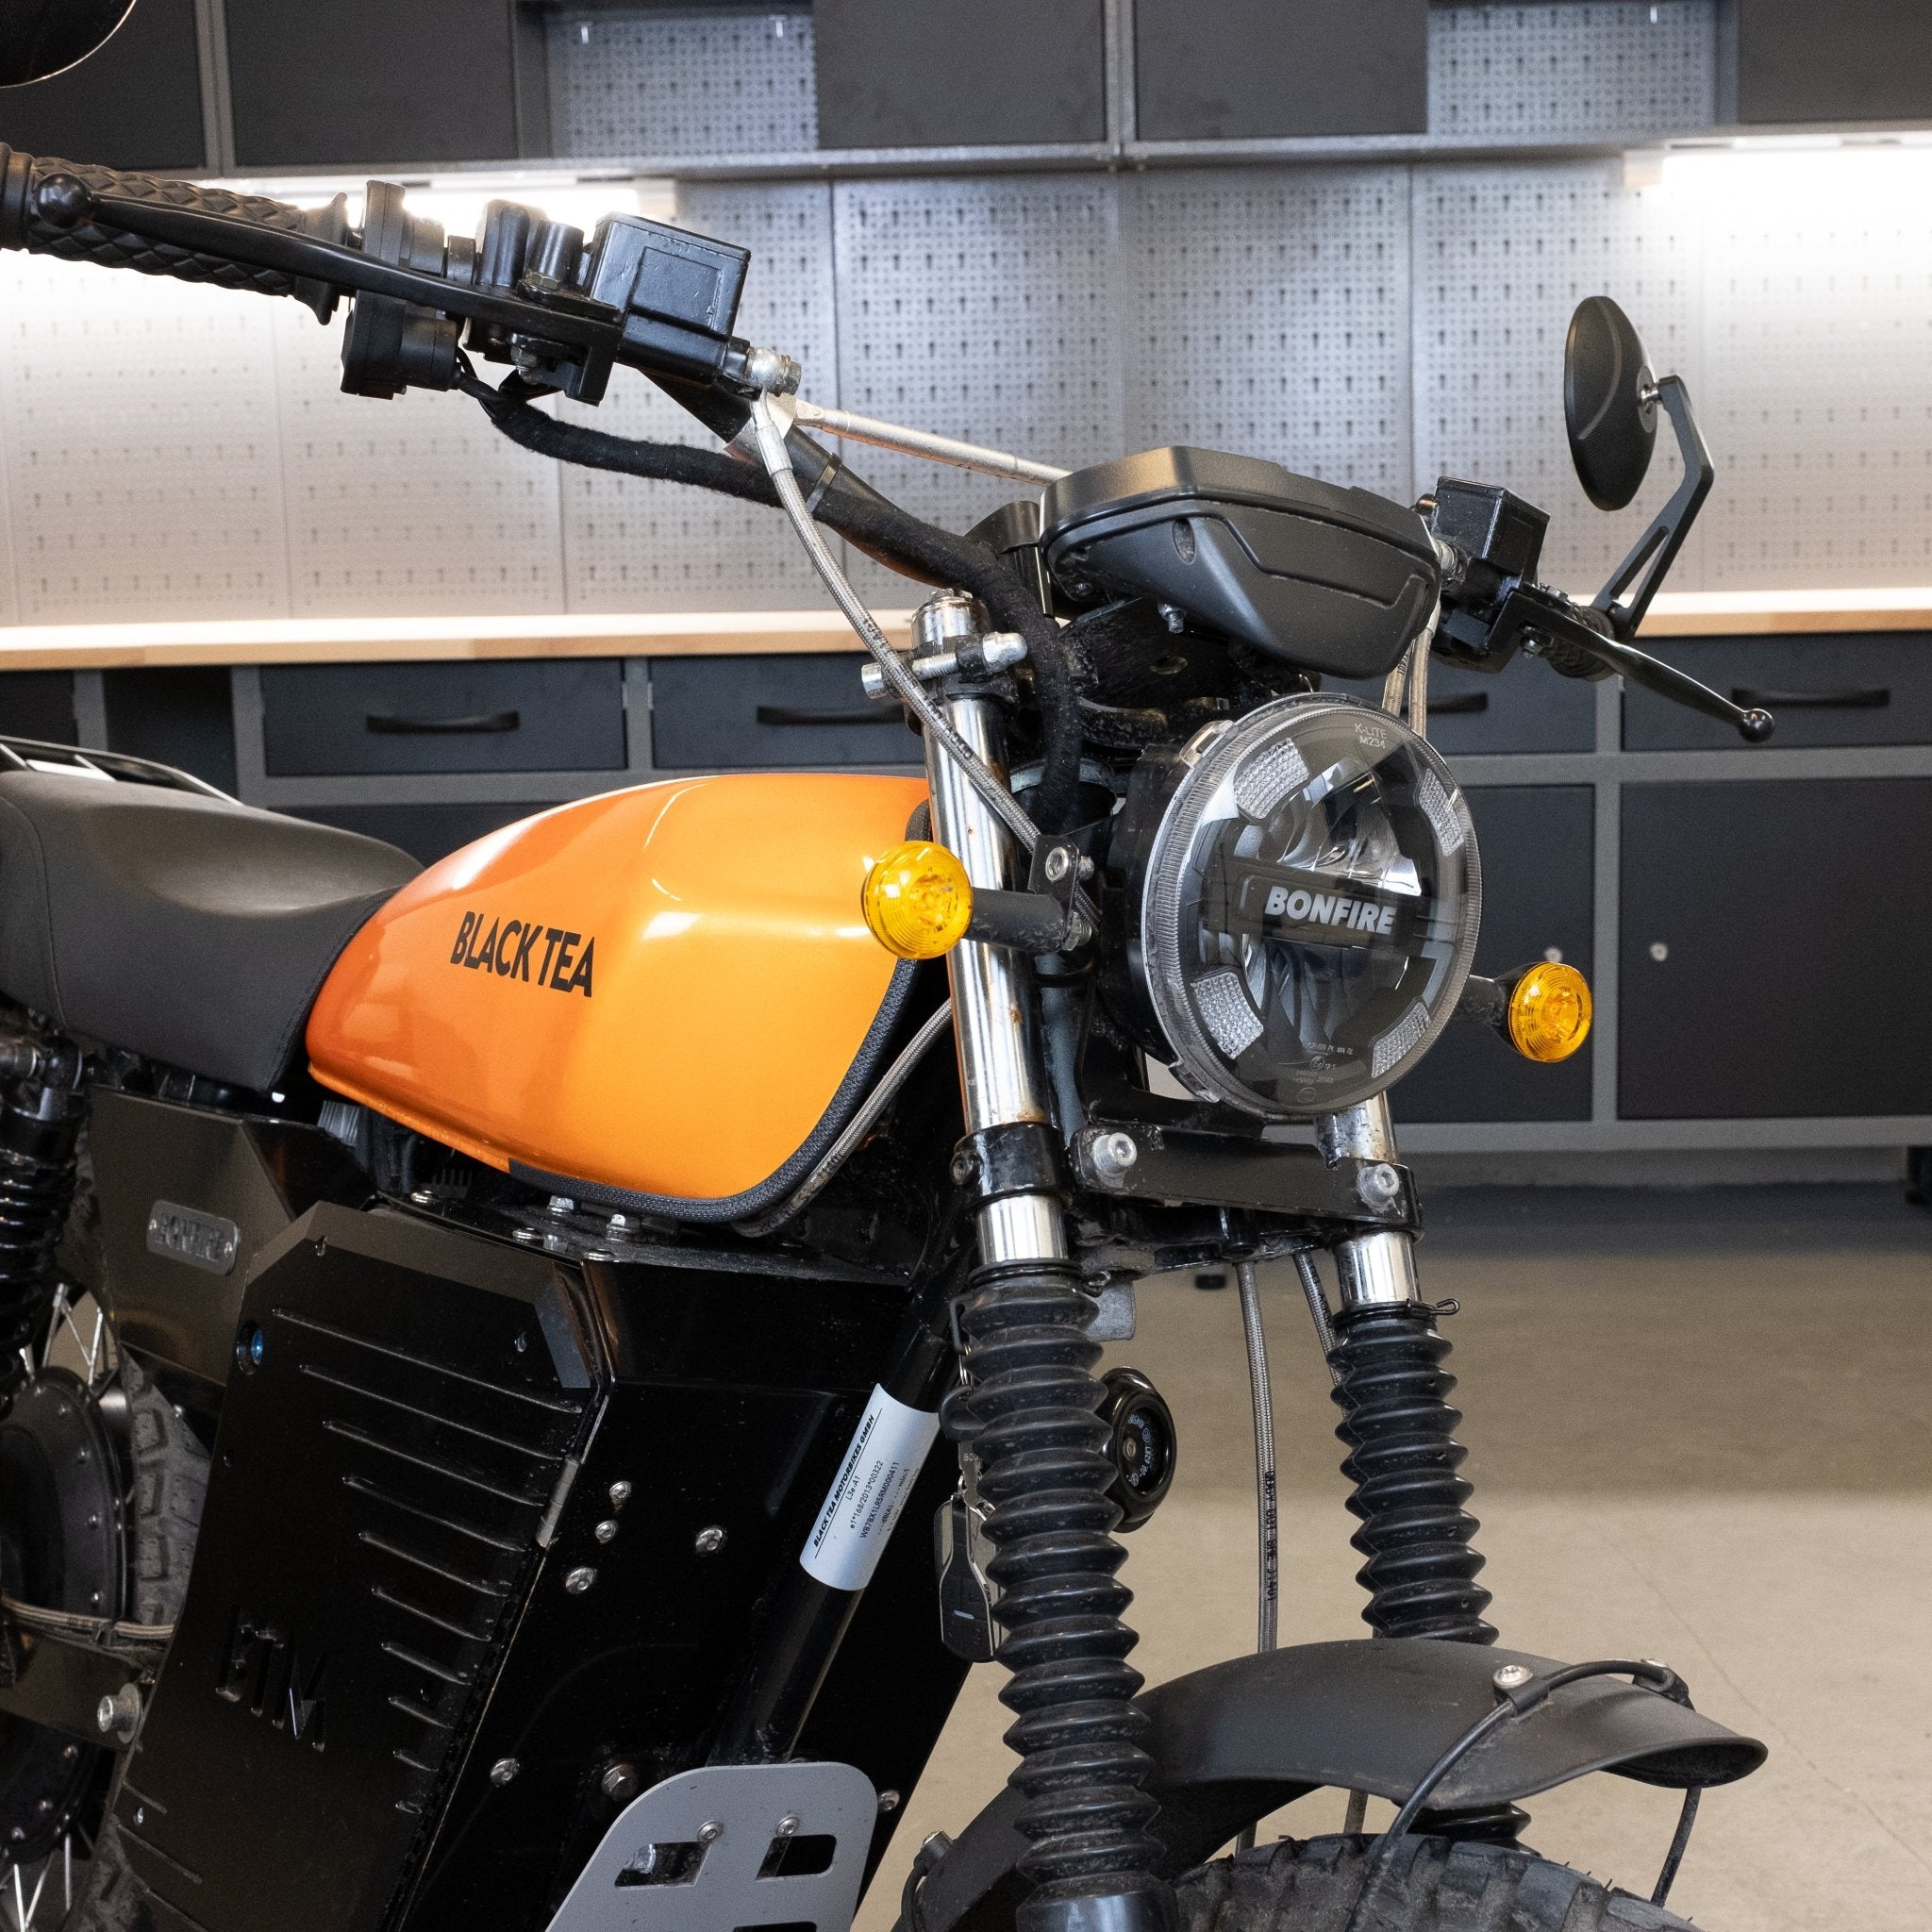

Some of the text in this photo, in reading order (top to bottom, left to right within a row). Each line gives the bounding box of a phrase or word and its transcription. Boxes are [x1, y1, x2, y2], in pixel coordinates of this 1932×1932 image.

[1354, 723, 1388, 740] K-LITE
[1264, 885, 1397, 935] BONFIRE
[450, 910, 595, 998] BLACK TEA
[813, 1414, 874, 1548] BLACK TEA MOTORBIKES GMBH
